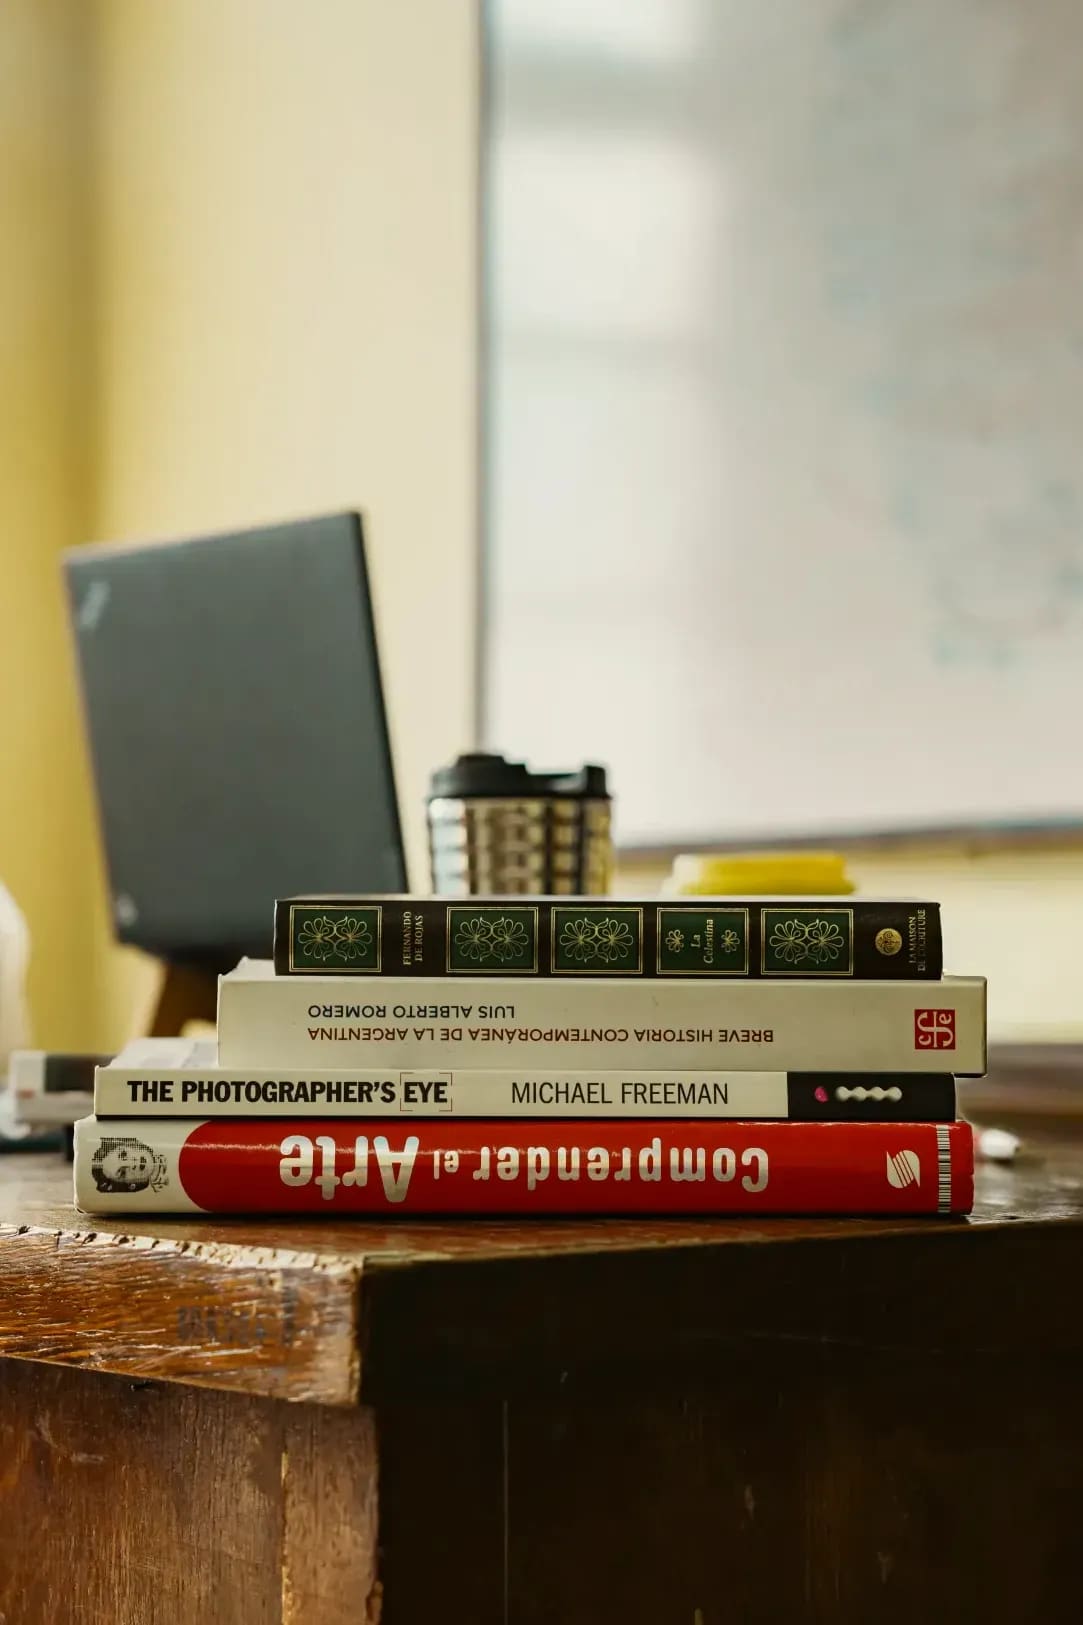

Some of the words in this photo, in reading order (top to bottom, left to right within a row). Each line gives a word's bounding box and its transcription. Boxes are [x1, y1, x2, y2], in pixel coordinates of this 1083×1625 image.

[415, 915, 424, 944] ROJAS
[403, 911, 412, 965] FERNANDO
[690, 935, 701, 948] La
[703, 919, 714, 964] Celestina
[415, 947, 423, 961] DE
[307, 1004, 387, 1018] ROMERO
[392, 1005, 473, 1019] ALBERTO
[478, 1005, 515, 1019] LUIS
[307, 1027, 409, 1041] ARGENTINA
[412, 1028, 434, 1041] LA
[440, 1028, 463, 1041] DE
[467, 1028, 629, 1044] CONTEMPORÁNEA
[633, 1028, 713, 1042] HISTORIA
[718, 1029, 774, 1043] BREVE
[127, 1080, 174, 1102] THE
[181, 1080, 396, 1103] PHOTOGRAPHER’S
[403, 1081, 448, 1103] EYE
[511, 1082, 613, 1104] MICHAEL
[620, 1082, 729, 1105] FREEMAN
[279, 1135, 420, 1203] Arte
[433, 1150, 460, 1180] el
[472, 1137, 769, 1192] Comprender
